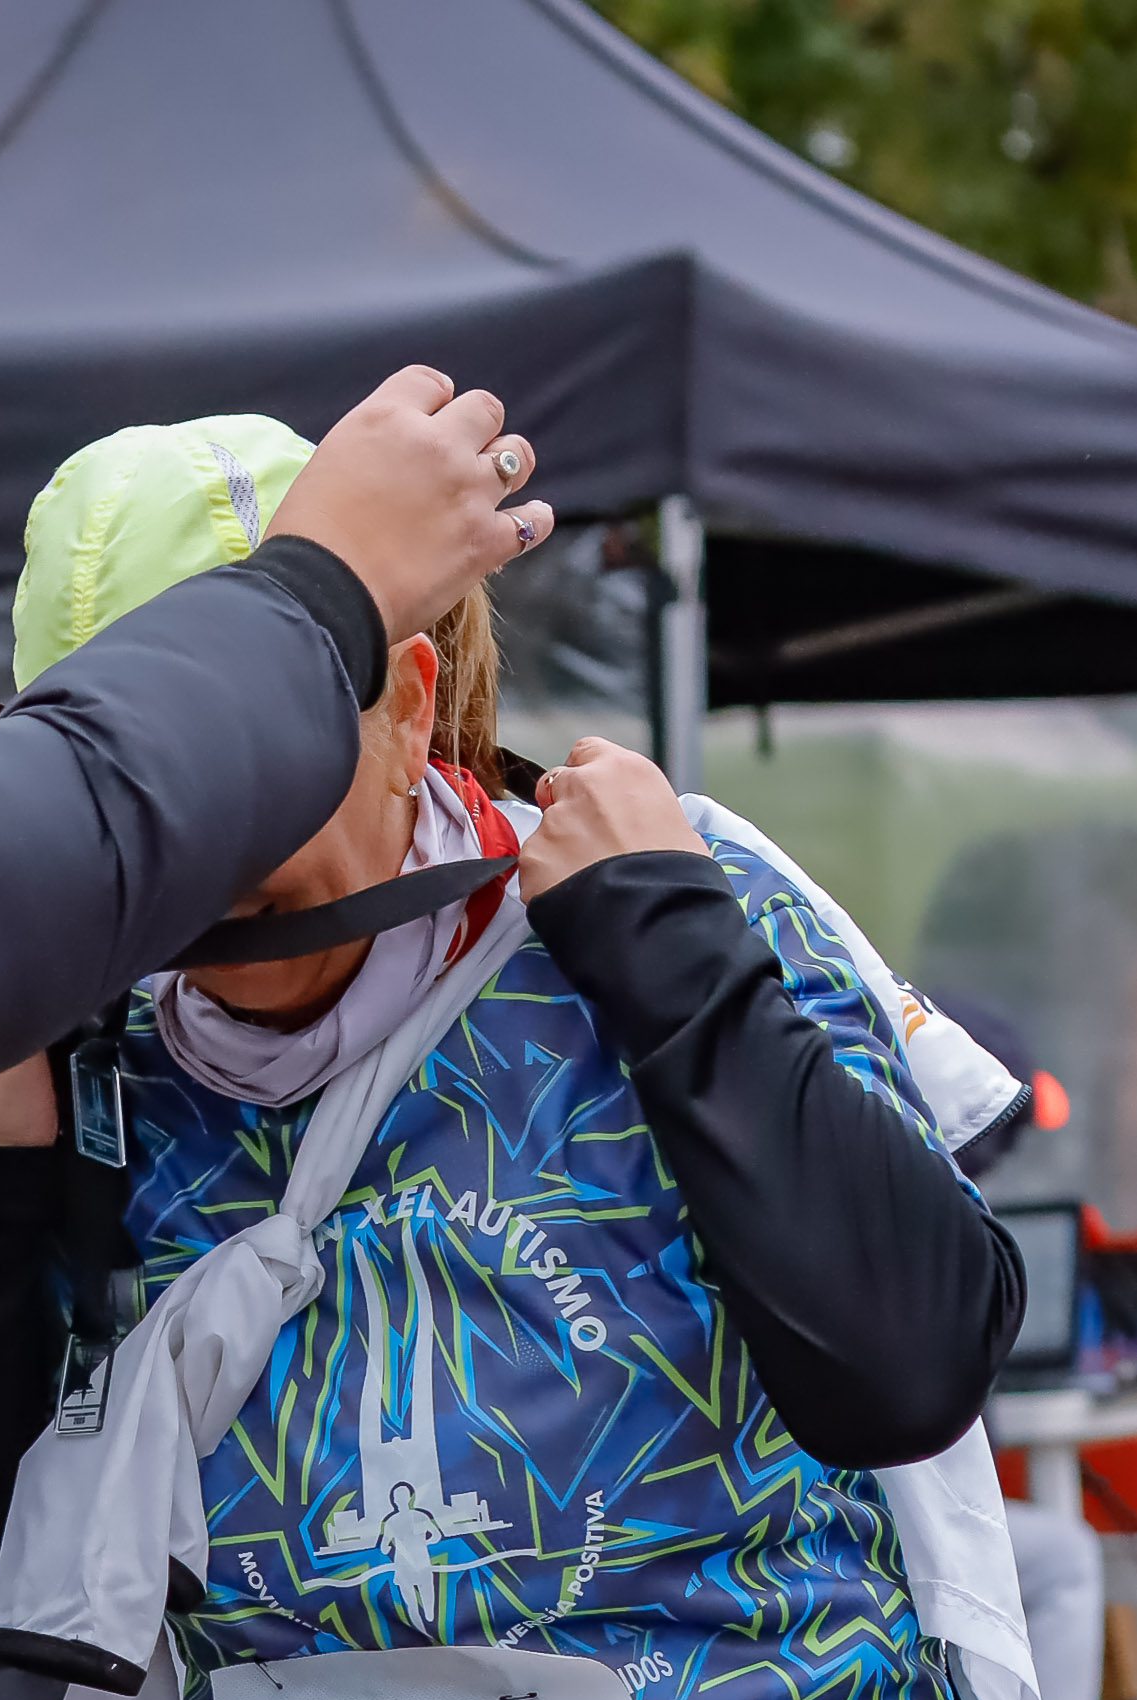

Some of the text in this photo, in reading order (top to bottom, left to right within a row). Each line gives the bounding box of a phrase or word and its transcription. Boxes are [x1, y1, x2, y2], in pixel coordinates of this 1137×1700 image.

[356, 1194, 386, 1229] X
[396, 1185, 435, 1219] EL
[446, 1191, 607, 1352] AUTISMO
[567, 1489, 605, 1597] POSITIVA
[616, 1651, 674, 1695] IDOS
